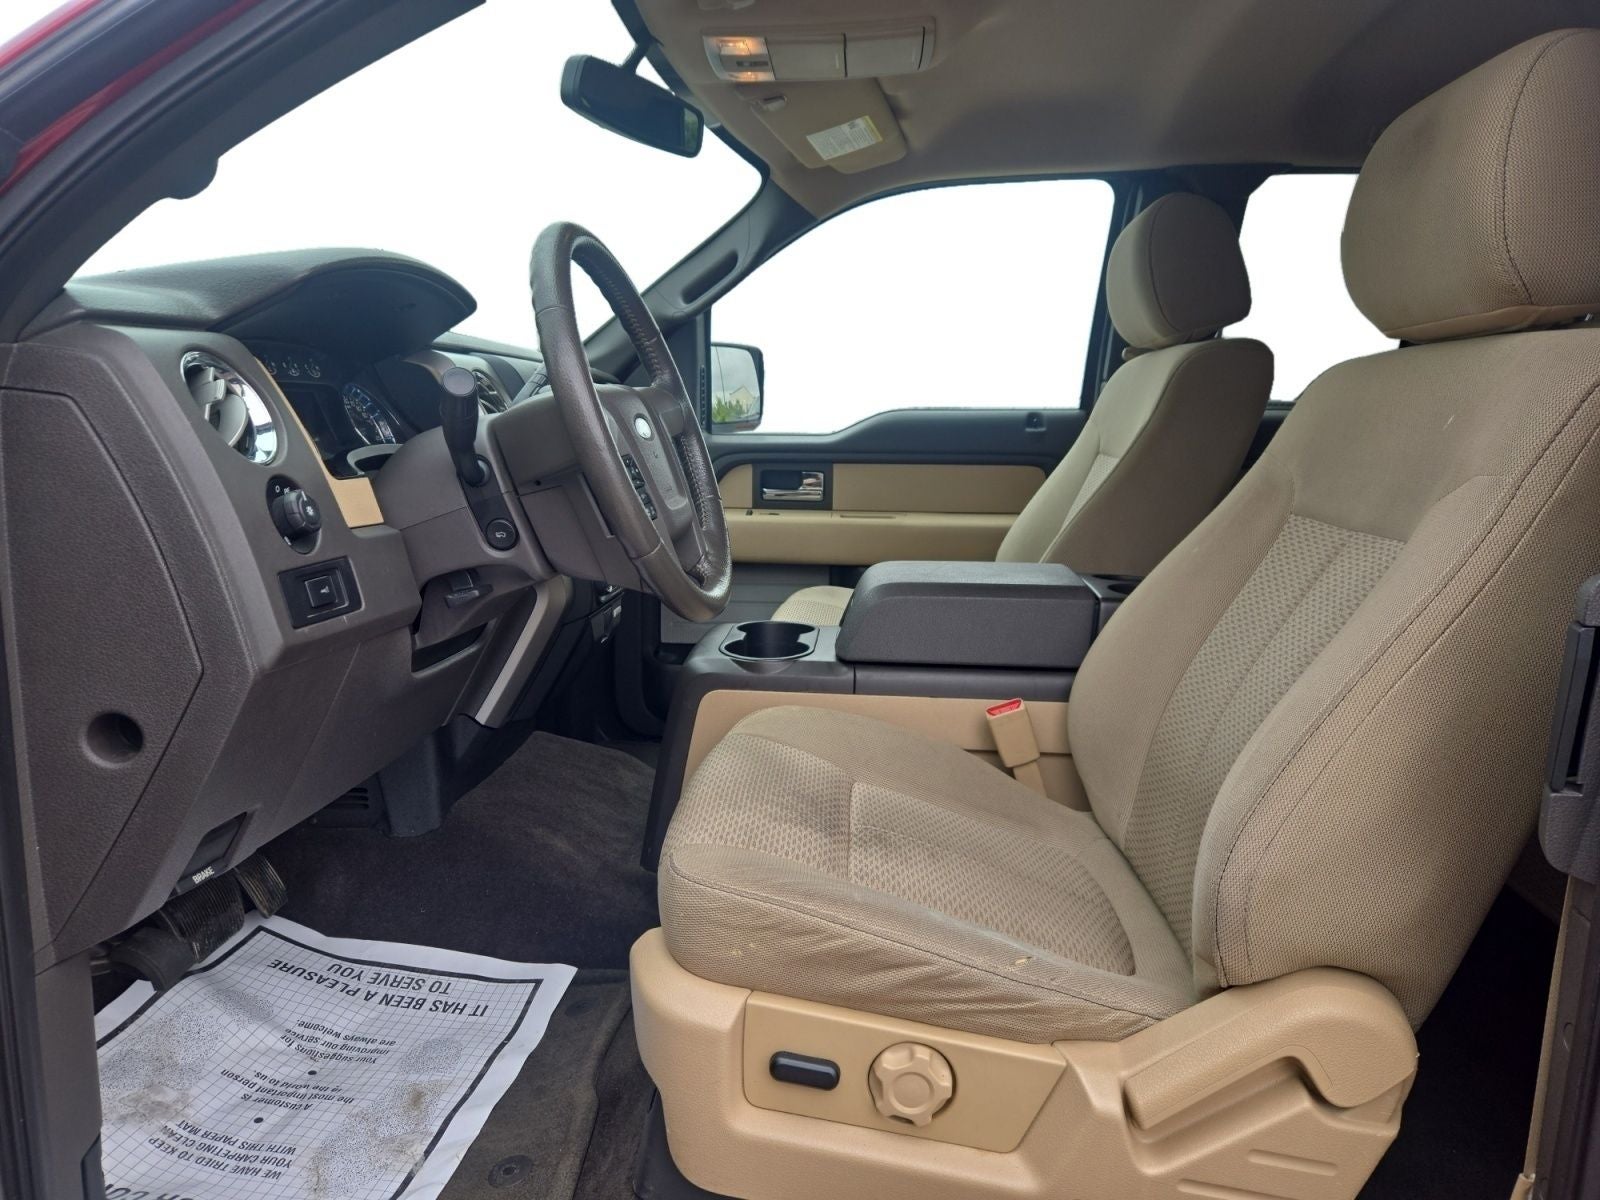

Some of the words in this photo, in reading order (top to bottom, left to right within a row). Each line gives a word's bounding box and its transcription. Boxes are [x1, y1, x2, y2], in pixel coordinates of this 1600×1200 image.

[192, 866, 215, 884] BRAKE
[266, 959, 360, 997] PLEASURE
[326, 964, 362, 982] YOU
[367, 972, 426, 991] SERVE
[429, 981, 451, 994] TO
[364, 990, 378, 1001] A
[378, 994, 426, 1010] BEEN
[429, 1000, 468, 1015] HAS
[468, 1004, 488, 1016] IT
[297, 1020, 341, 1038] welcome.
[280, 1035, 295, 1047] for
[285, 1029, 320, 1044] service
[343, 1035, 378, 1045] always
[320, 1041, 339, 1050] our
[340, 1044, 389, 1054] improving
[295, 1044, 353, 1062] suggestions
[220, 1069, 257, 1088] person
[254, 1070, 268, 1080] us.
[269, 1078, 279, 1086] to
[280, 1082, 310, 1090] world
[255, 1086, 307, 1100] important
[252, 1098, 302, 1110] customer
[175, 1120, 201, 1135] MAT
[160, 1126, 196, 1148] CLEAN
[201, 1131, 238, 1146] PAPER
[148, 1137, 178, 1155] KEEP
[196, 1142, 259, 1163] CARPETING
[238, 1141, 264, 1152] THIS
[266, 1144, 296, 1155] WITH
[178, 1151, 194, 1161] TO
[260, 1155, 292, 1168] YOUR
[195, 1156, 229, 1172] TRIED
[230, 1165, 261, 1176] HAVE
[262, 1170, 282, 1179] WE
